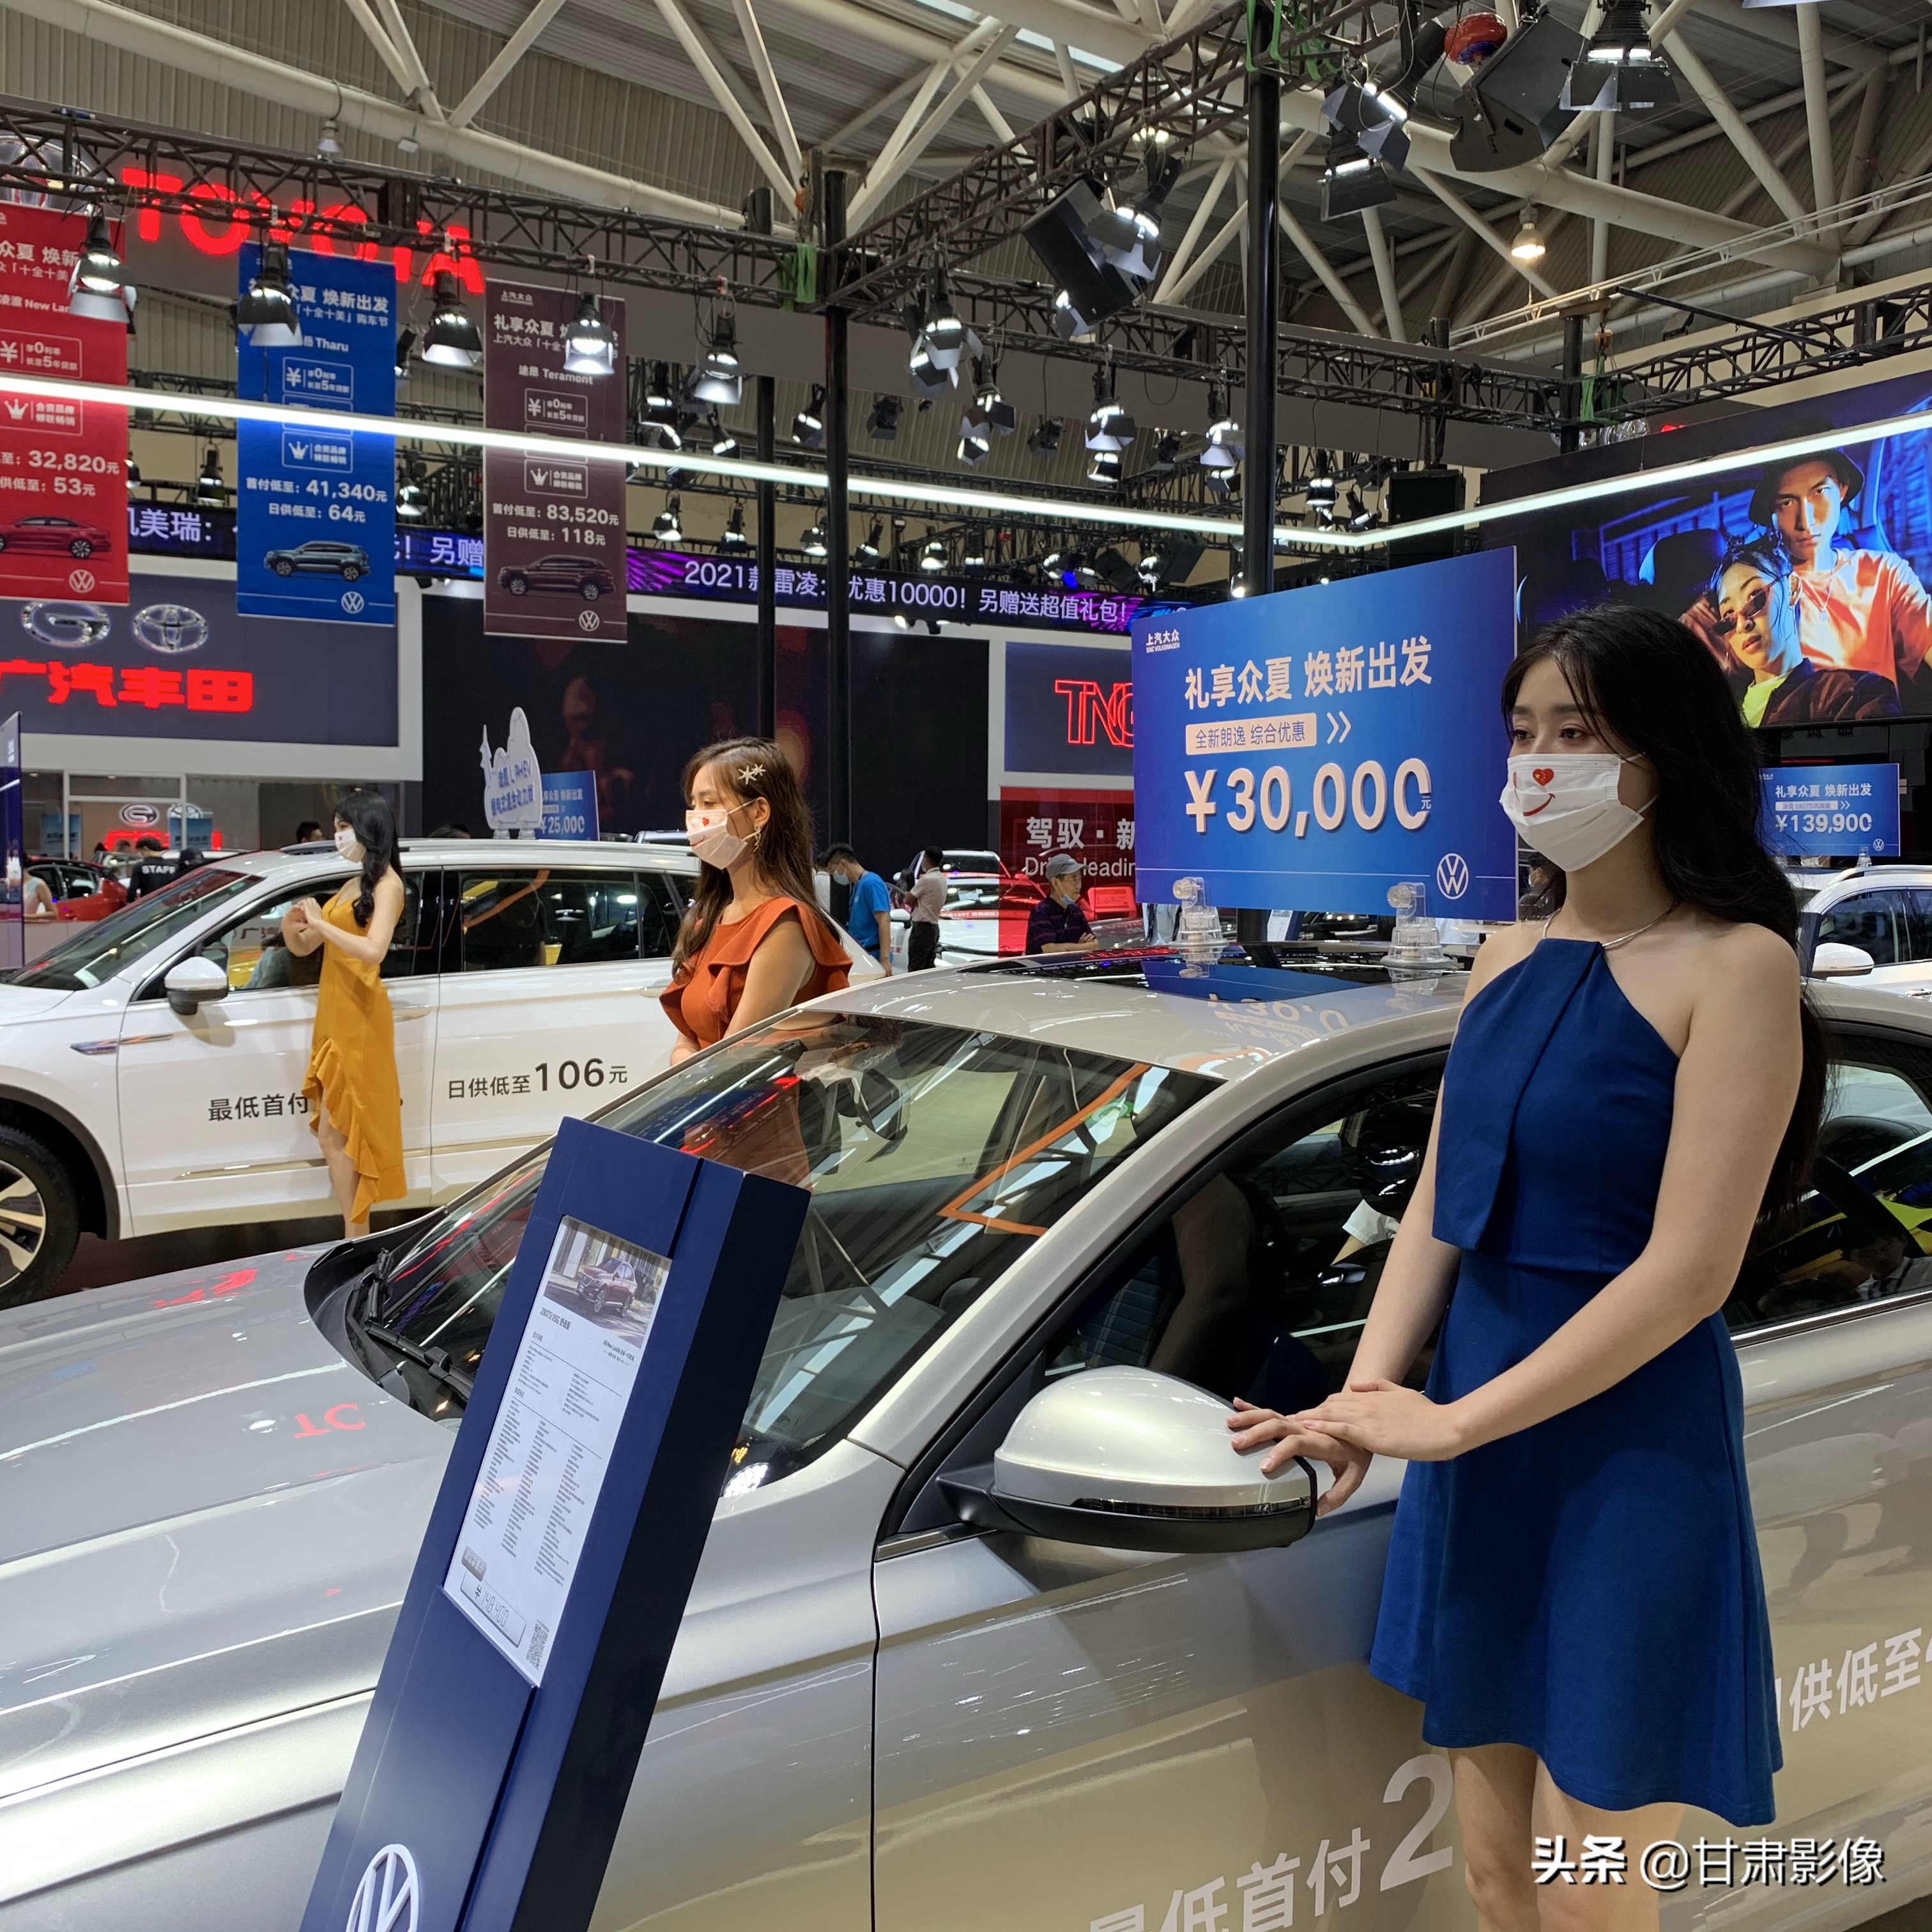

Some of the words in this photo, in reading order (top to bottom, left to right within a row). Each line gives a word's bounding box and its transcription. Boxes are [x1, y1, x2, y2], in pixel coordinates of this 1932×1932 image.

[24, 298, 50, 311] New
[323, 289, 388, 314] 焕新出发
[493, 313, 555, 337] 礼享众夏
[316, 337, 349, 352] Tharu
[542, 369, 594, 385] Teramont
[28, 450, 120, 475] 32,820元
[54, 477, 96, 497] 53元
[306, 480, 388, 502] 41,340元
[328, 504, 367, 523] 64元
[547, 504, 619, 526] 83,520元
[562, 527, 606, 546] 118元
[1146, 629, 1179, 646] 上汽大众
[1184, 656, 1292, 710] 礼享众夏
[1304, 636, 1432, 698] 焕新出发
[0, 658, 253, 714] 广汽丰田
[1195, 724, 1246, 749] 全新朗逸
[1250, 721, 1306, 746] 综合优惠
[1775, 785, 1820, 797] 礼享众夏
[1825, 783, 1872, 797] 焕新出发
[141, 864, 176, 875] STAFF
[208, 1092, 311, 1123] 最低首付
